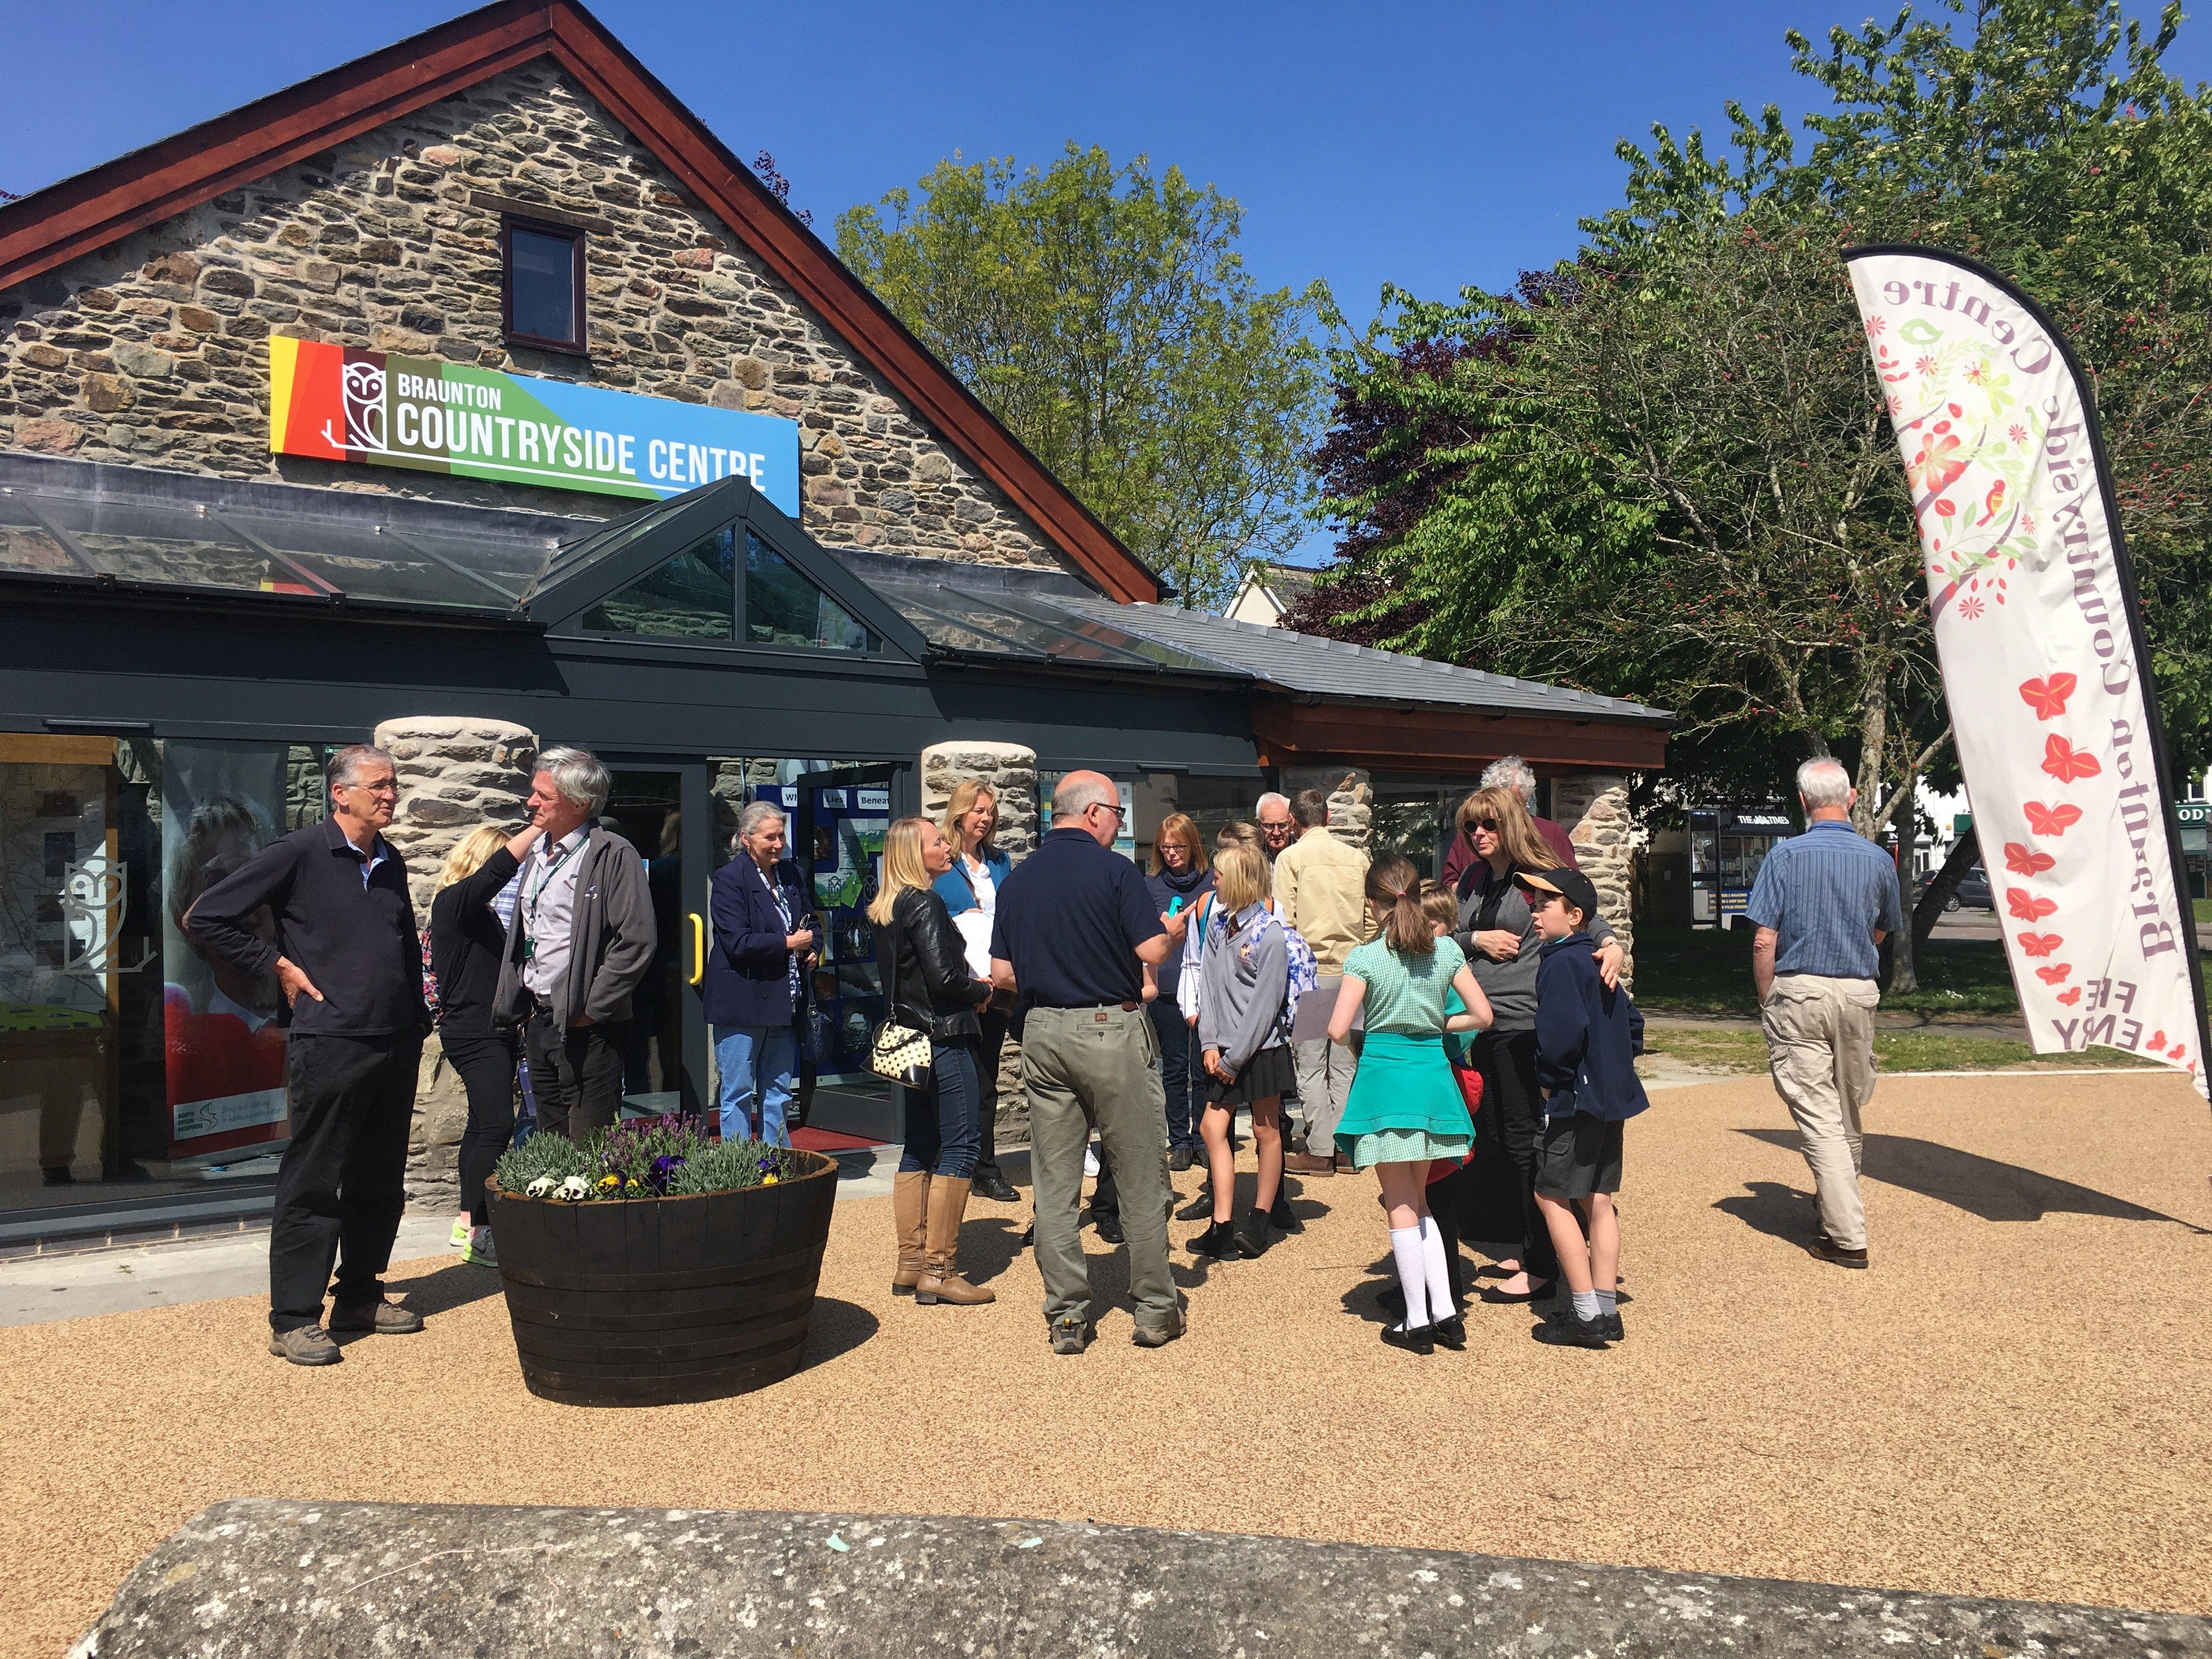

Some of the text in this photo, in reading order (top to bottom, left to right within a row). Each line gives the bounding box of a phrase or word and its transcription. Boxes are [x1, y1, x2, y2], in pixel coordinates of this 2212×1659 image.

[398, 372, 501, 409] BRAUNTON
[397, 402, 766, 492] COUNTRYSIDE CENTRE
[1737, 815, 1790, 825] THE TIMES
